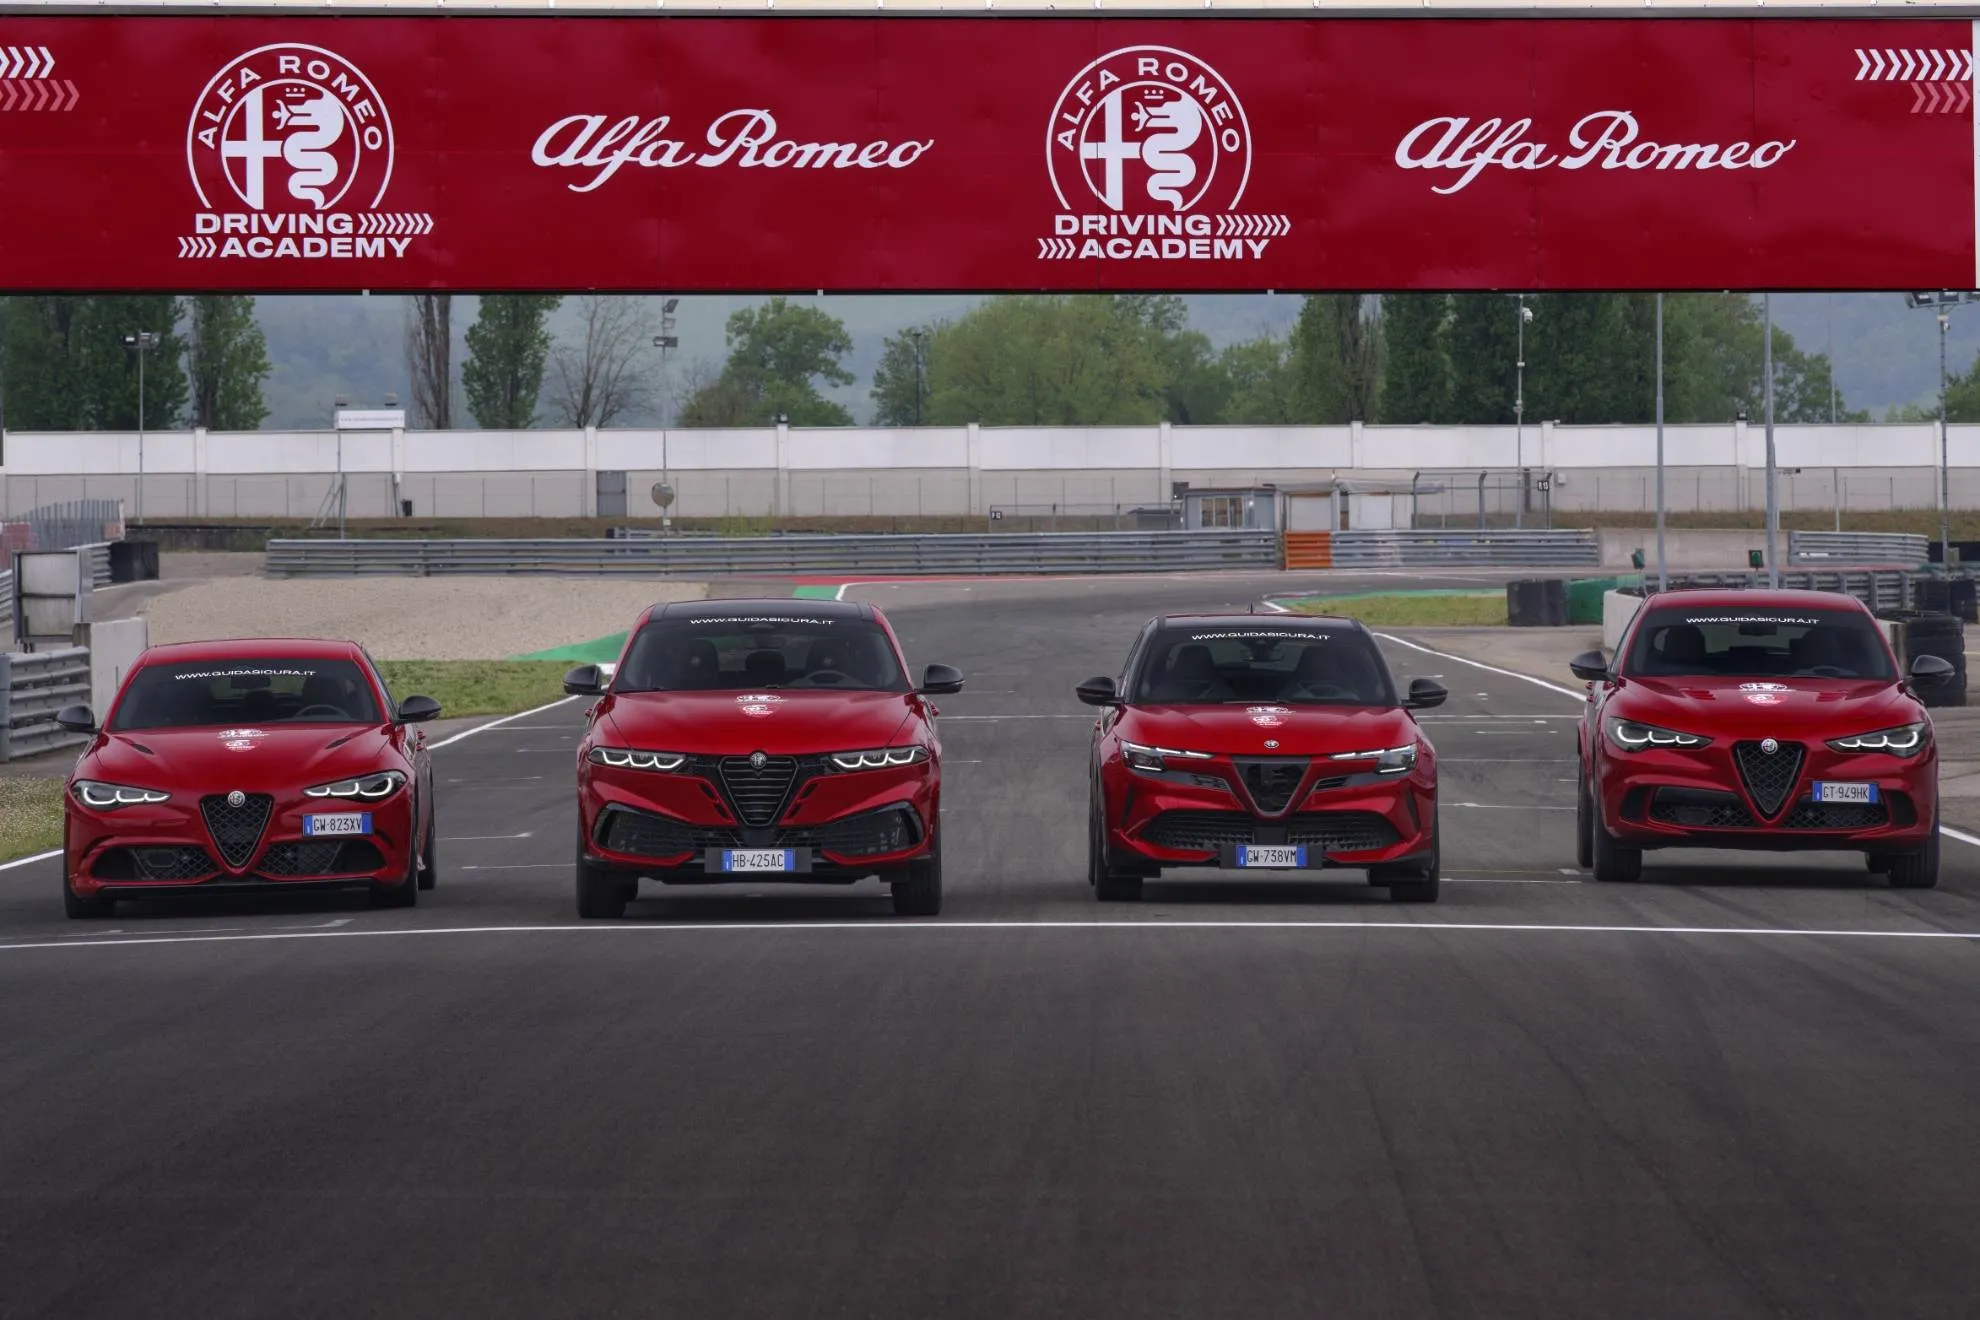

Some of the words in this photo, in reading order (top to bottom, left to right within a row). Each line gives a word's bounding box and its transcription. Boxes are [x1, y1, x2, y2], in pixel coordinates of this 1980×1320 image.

[198, 67, 261, 149] ALFA
[279, 55, 383, 150] ROMEO
[1057, 68, 1121, 152] ALFA
[1137, 57, 1240, 153] ROMEO
[531, 114, 696, 193] Alfa
[696, 108, 934, 169] Romeo
[1395, 116, 1559, 195] Alfa
[1558, 110, 1797, 170] Romeo
[195, 213, 353, 235] DRIVING
[1055, 214, 1211, 236] DRIVING
[219, 236, 413, 258] ACADEMY
[1078, 238, 1270, 260] ACADEMY
[689, 617, 836, 625] WWW.GUIDASICURA.IT
[1685, 616, 1821, 625] WWW.GUIDASICURA.IT
[1191, 631, 1331, 641] WWW.GUIDASICURA.IT
[174, 669, 317, 681] WWW.GUIDASICURA.IT
